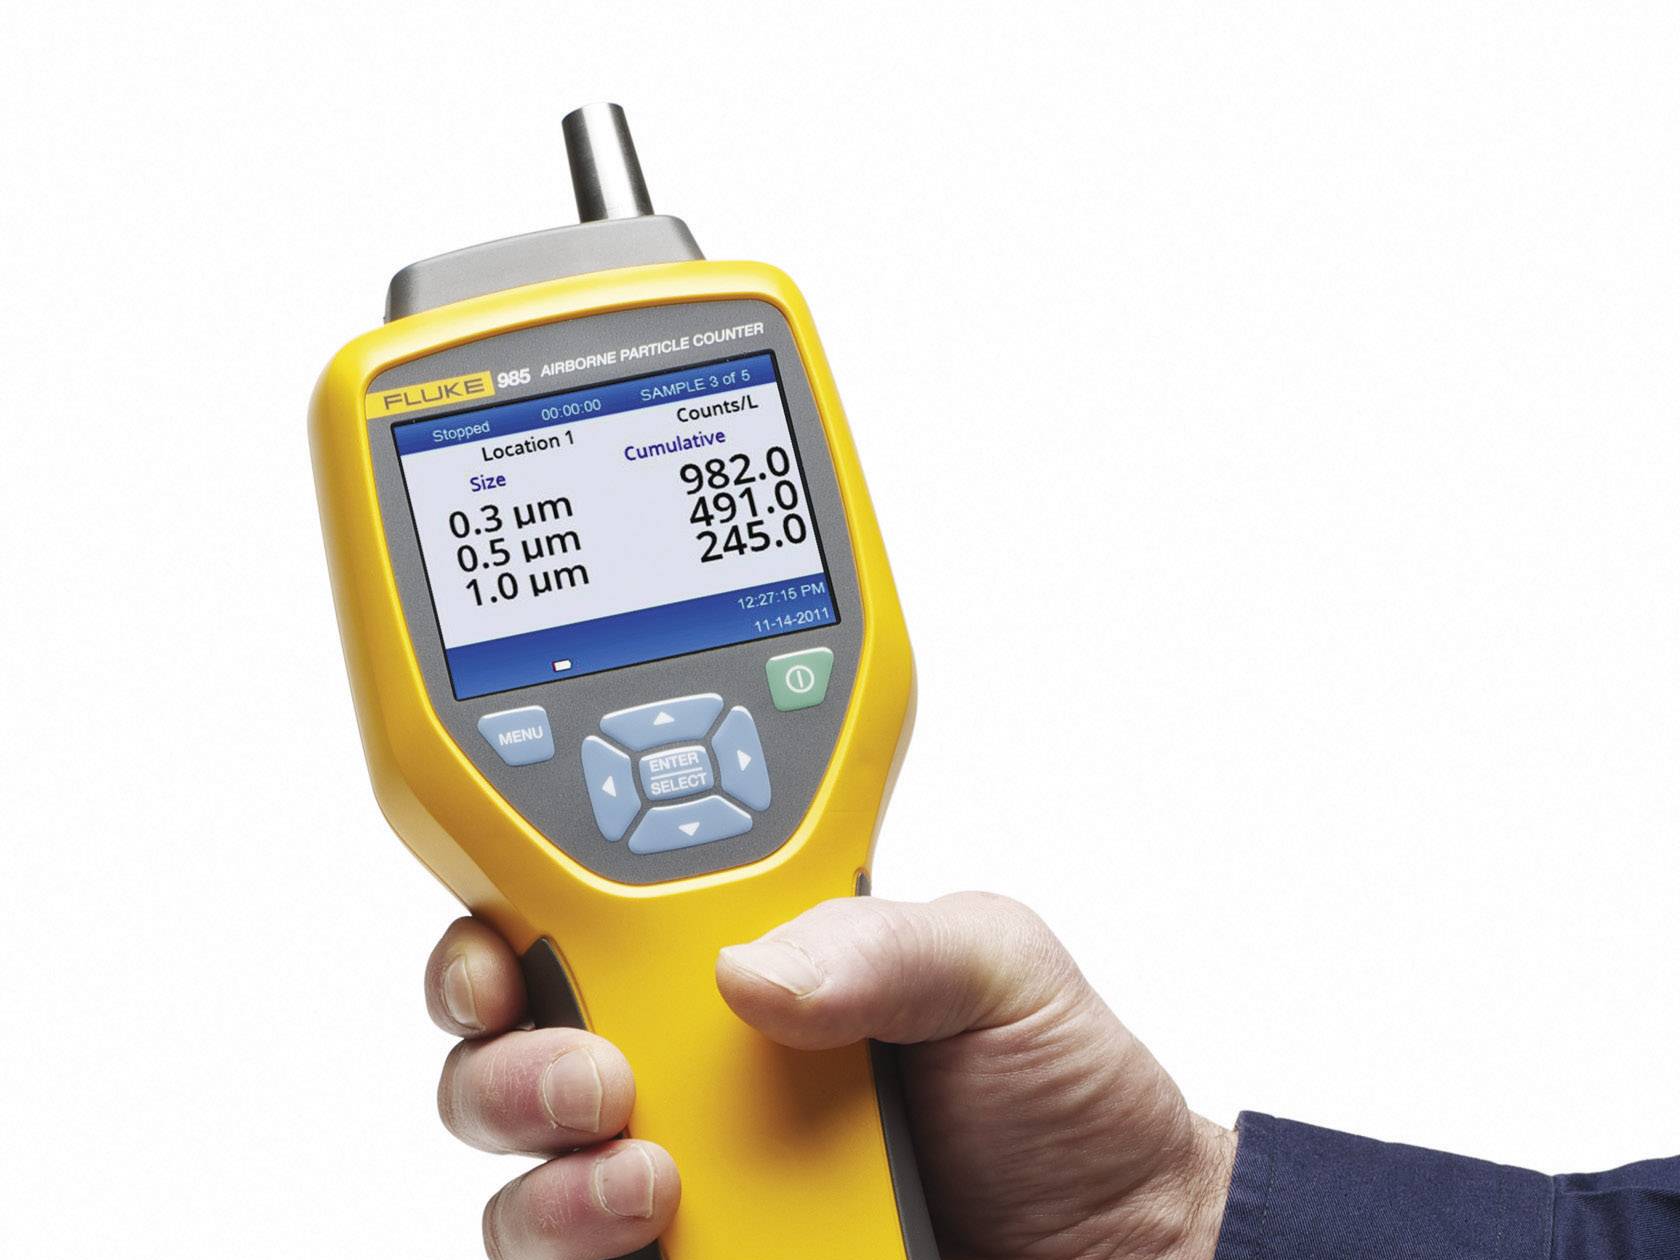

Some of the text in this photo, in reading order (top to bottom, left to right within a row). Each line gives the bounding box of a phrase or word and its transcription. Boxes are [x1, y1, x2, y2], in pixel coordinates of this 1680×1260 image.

[497, 322, 764, 388] 985 AIRBORNE PARTICLE COUNTER
[383, 378, 485, 410] FLUKE
[640, 369, 751, 401] SAMPLE 3 of 5
[541, 399, 601, 421] 00:00:00
[677, 395, 758, 423] Counts/L
[433, 422, 490, 442] Stopped
[481, 431, 575, 462] Location 1
[624, 430, 725, 461] Cumulative
[470, 474, 507, 492] Size
[679, 446, 790, 495] 982.0
[690, 480, 799, 526] 491.0
[449, 504, 502, 538] 0.3
[697, 513, 807, 562] 245.0
[457, 538, 510, 572] 0.5
[466, 572, 518, 606] 1.0
[738, 581, 825, 610] 12:27:15 PM
[754, 607, 830, 632] 11-14-2011
[498, 726, 544, 746] MENU
[649, 753, 699, 772] ENTER
[651, 773, 707, 795] SELECT
